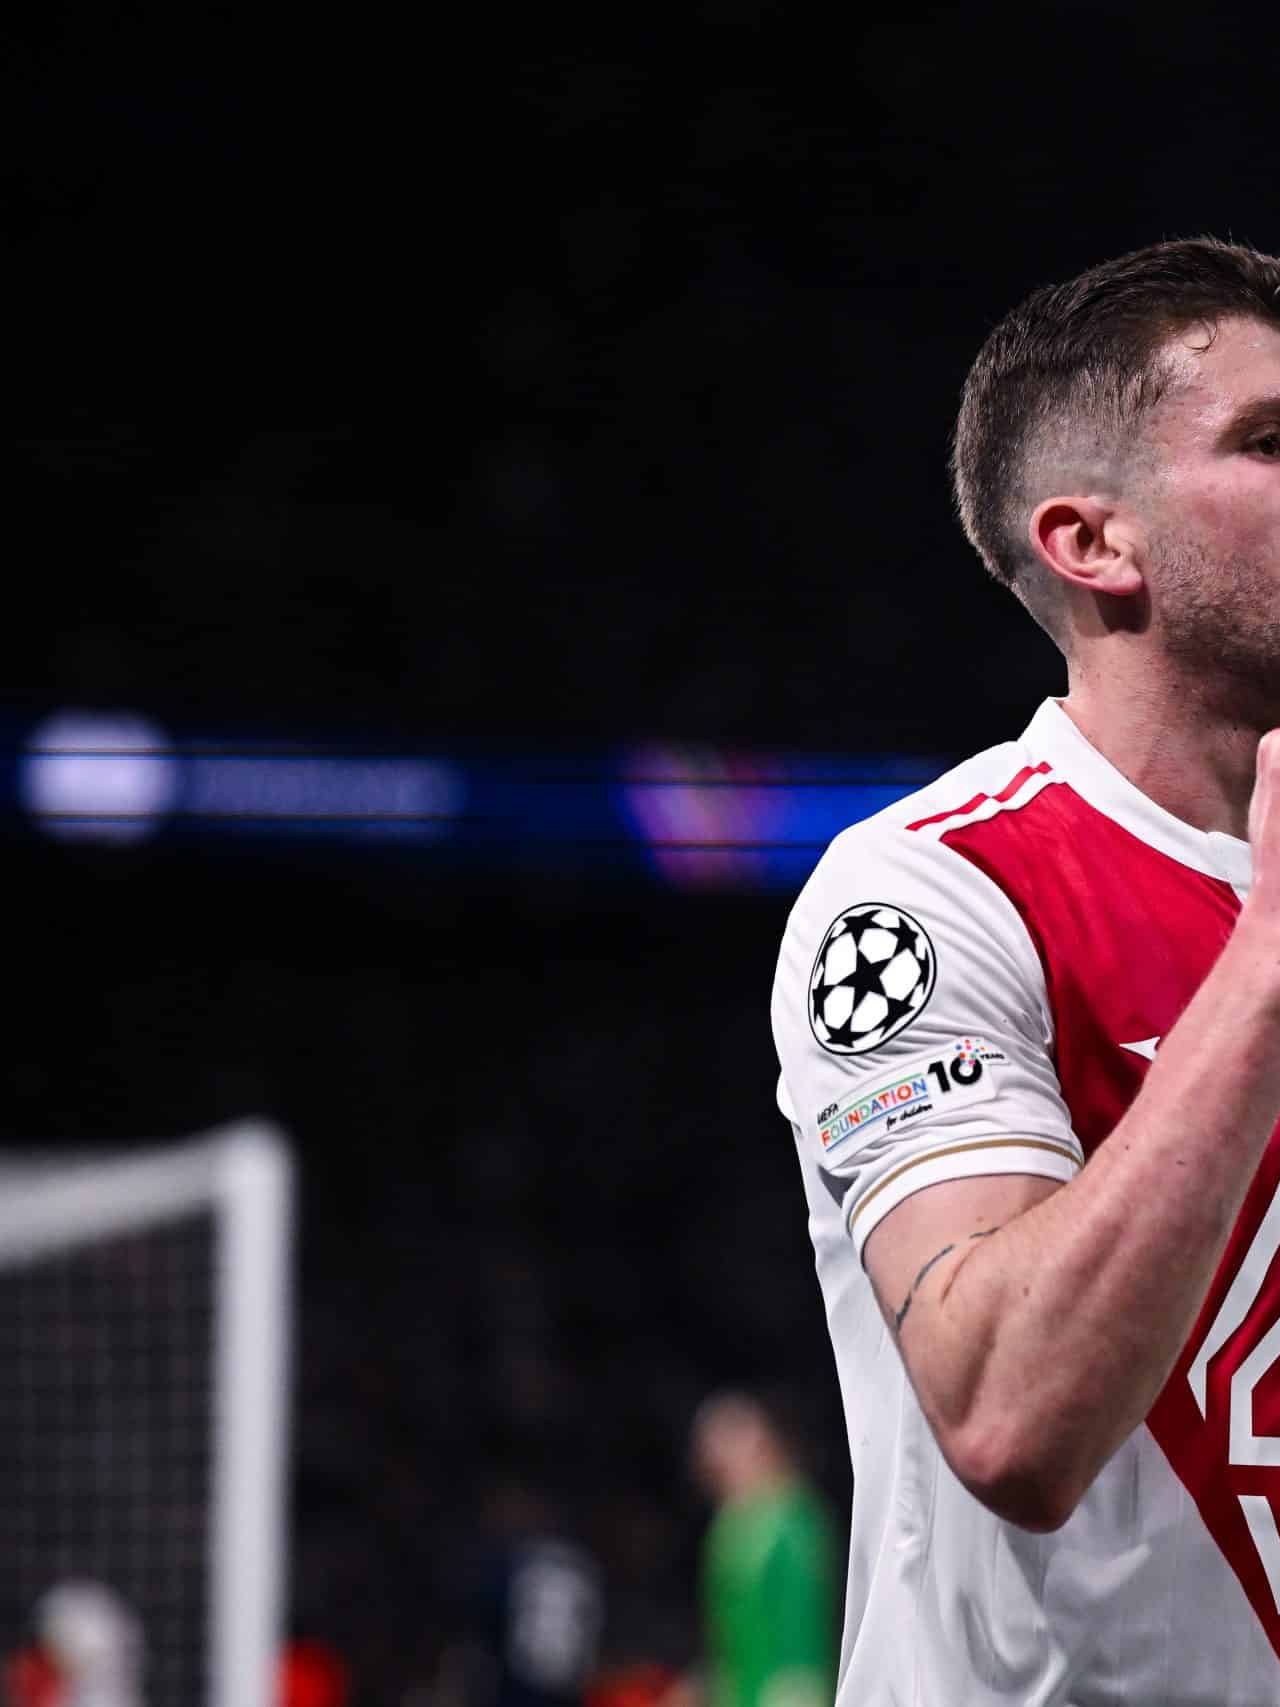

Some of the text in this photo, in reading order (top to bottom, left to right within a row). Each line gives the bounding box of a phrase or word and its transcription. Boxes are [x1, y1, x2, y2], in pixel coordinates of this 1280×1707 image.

[928, 1055, 983, 1093] 10
[817, 1103, 839, 1125] UEFA
[821, 1078, 927, 1147] FOUNDATION
